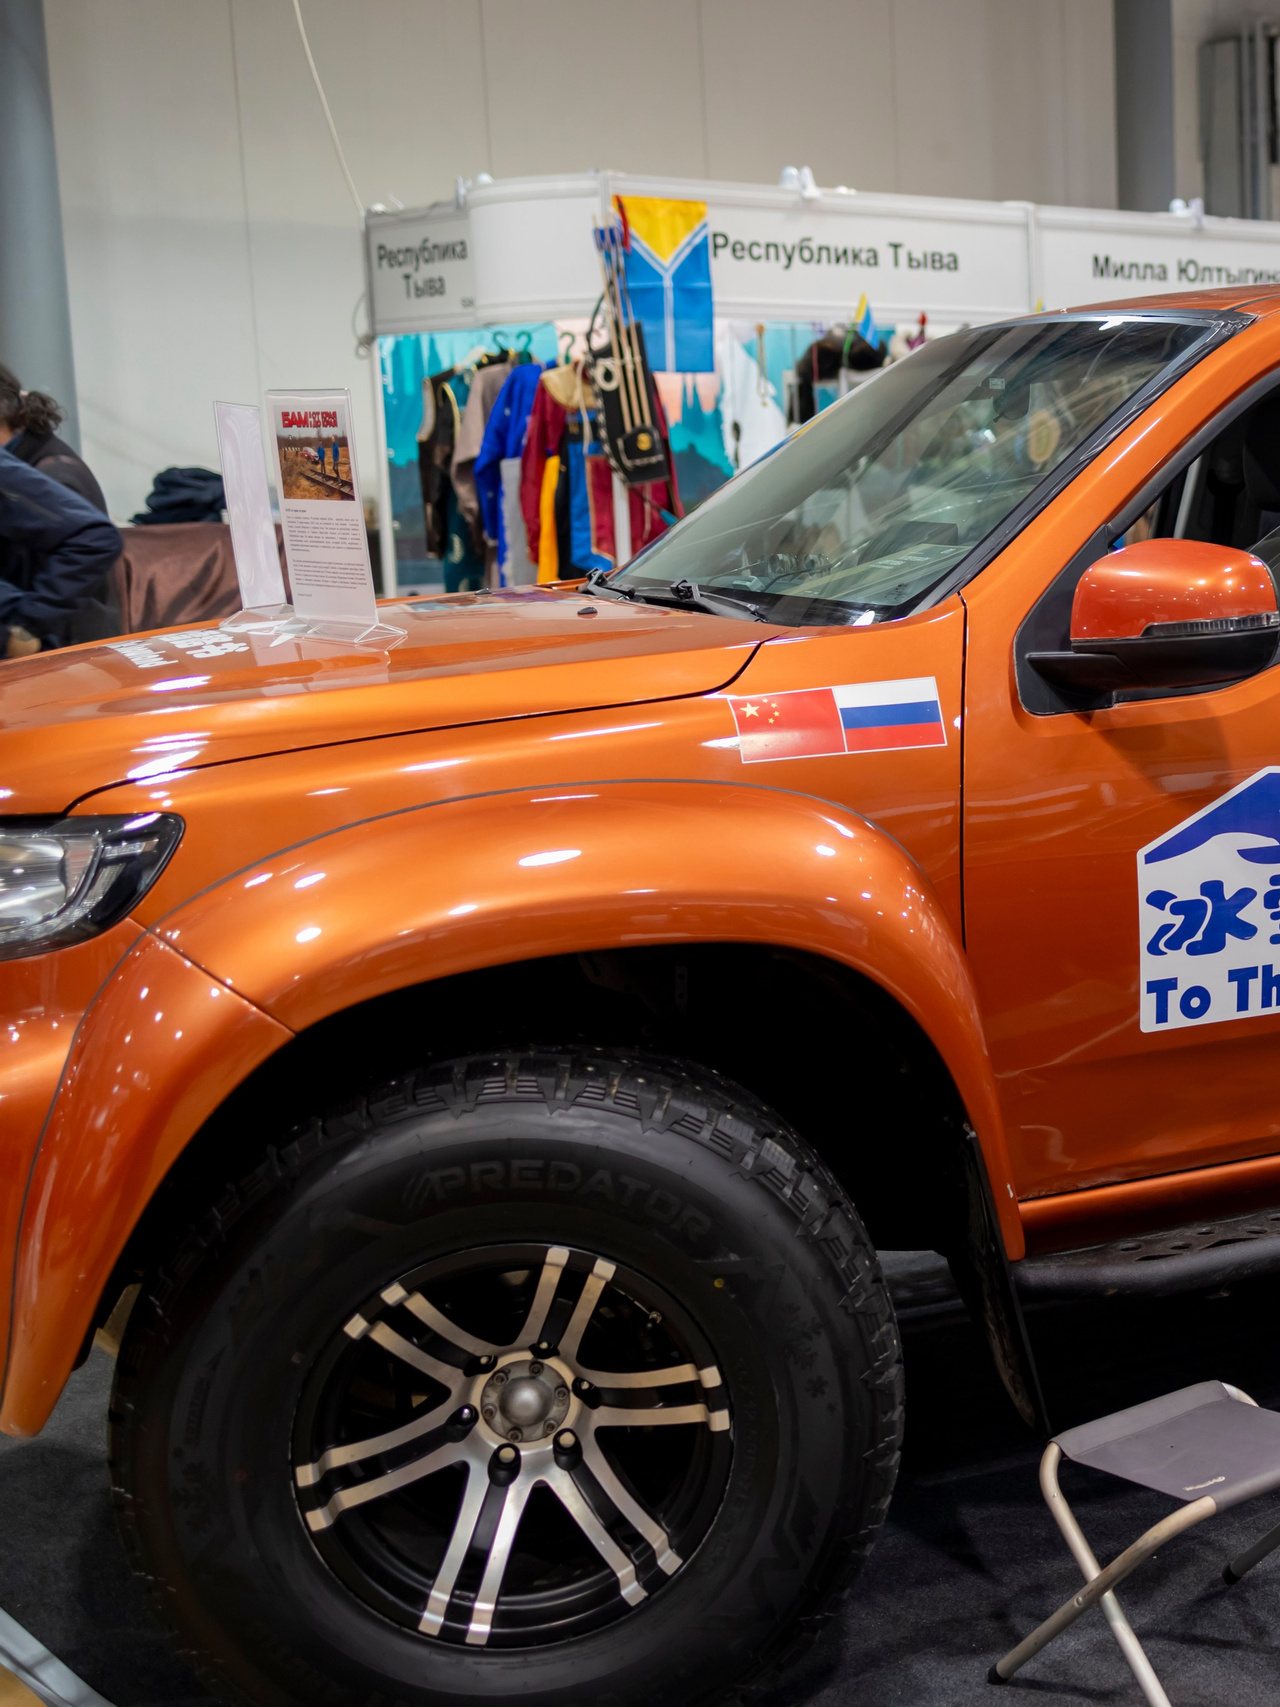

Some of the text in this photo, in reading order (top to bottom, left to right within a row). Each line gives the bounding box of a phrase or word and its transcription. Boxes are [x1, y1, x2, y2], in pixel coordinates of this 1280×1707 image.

[377, 238, 468, 271] Республика
[711, 232, 959, 272] Республика Тыва
[1092, 254, 1168, 281] Милла
[402, 273, 446, 299] Тыва
[281, 411, 309, 428] БАМ
[1146, 976, 1212, 1025] To
[424, 1158, 713, 1244] PREDATOR
